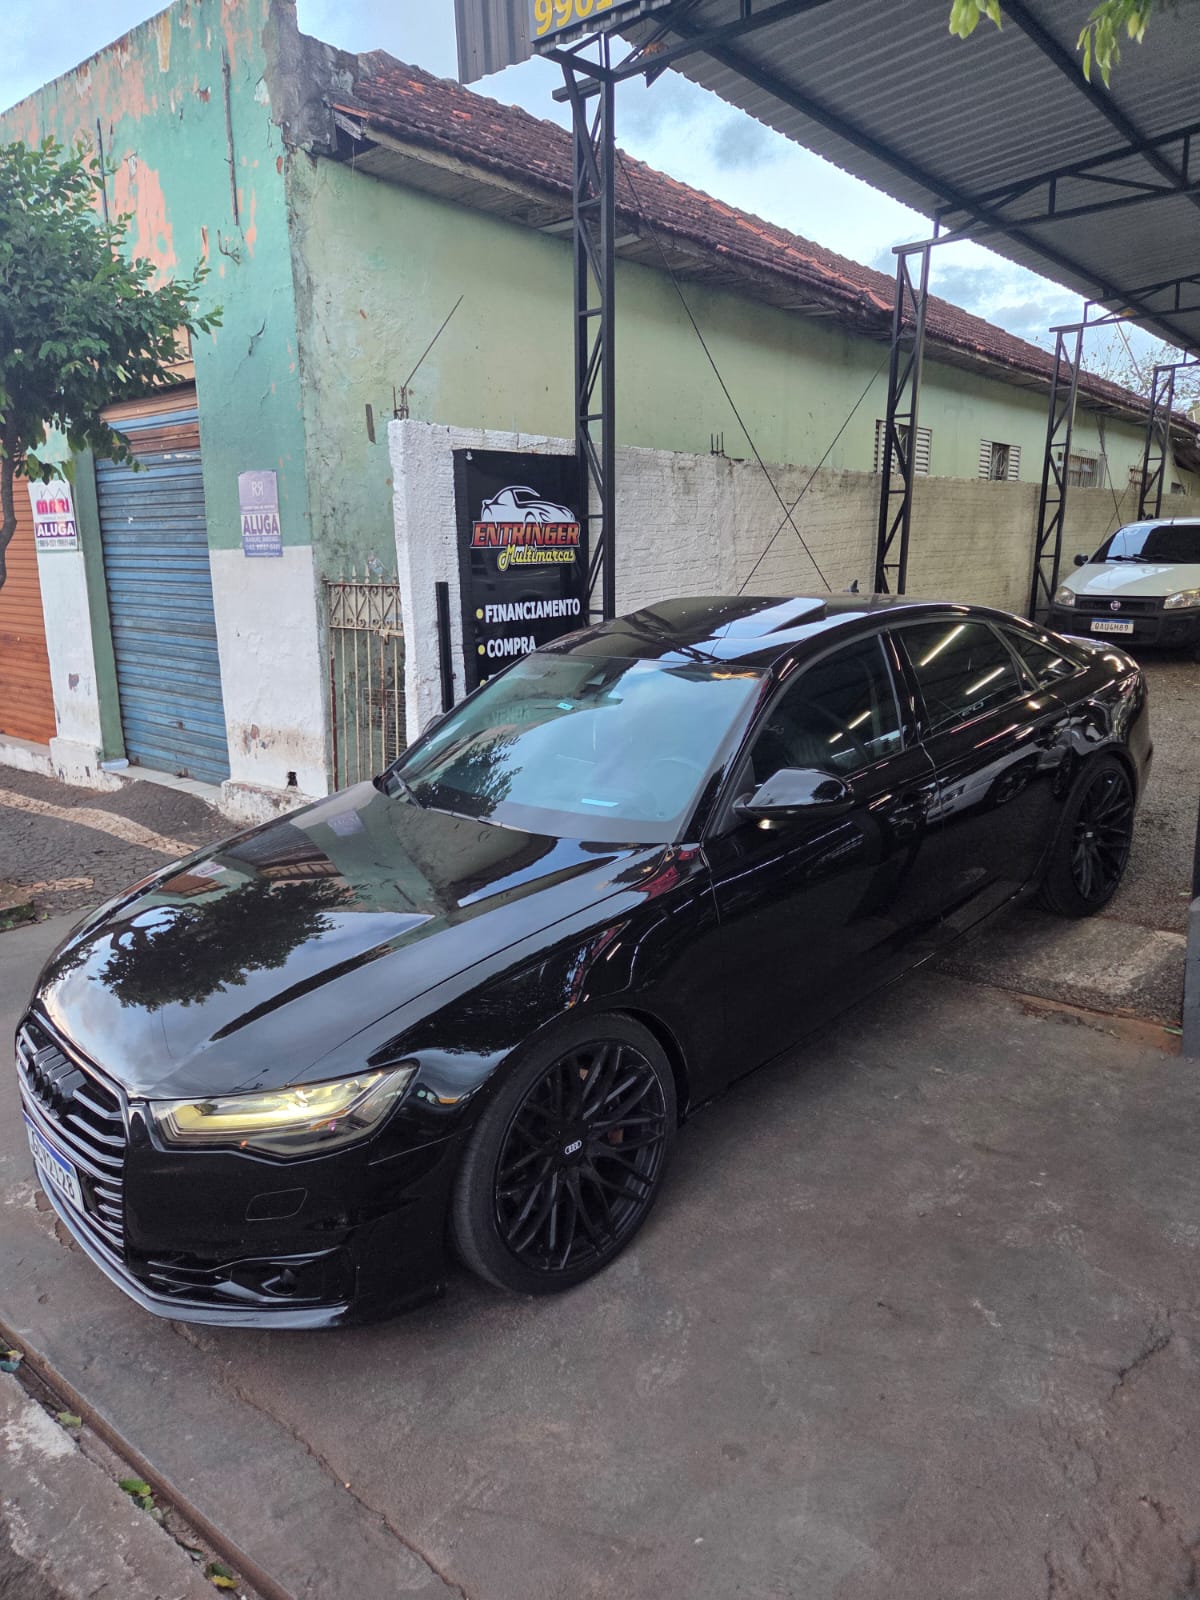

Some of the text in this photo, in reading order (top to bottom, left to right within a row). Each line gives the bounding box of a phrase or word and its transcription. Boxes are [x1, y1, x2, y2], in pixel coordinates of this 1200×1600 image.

[37, 522, 75, 537] ALUGA
[243, 514, 280, 536] ALUGA
[471, 521, 581, 548] ENTRINGER
[497, 543, 576, 572] Multimarcas
[485, 598, 581, 623] FINANCIAMENTO
[486, 635, 537, 658] COMPRA
